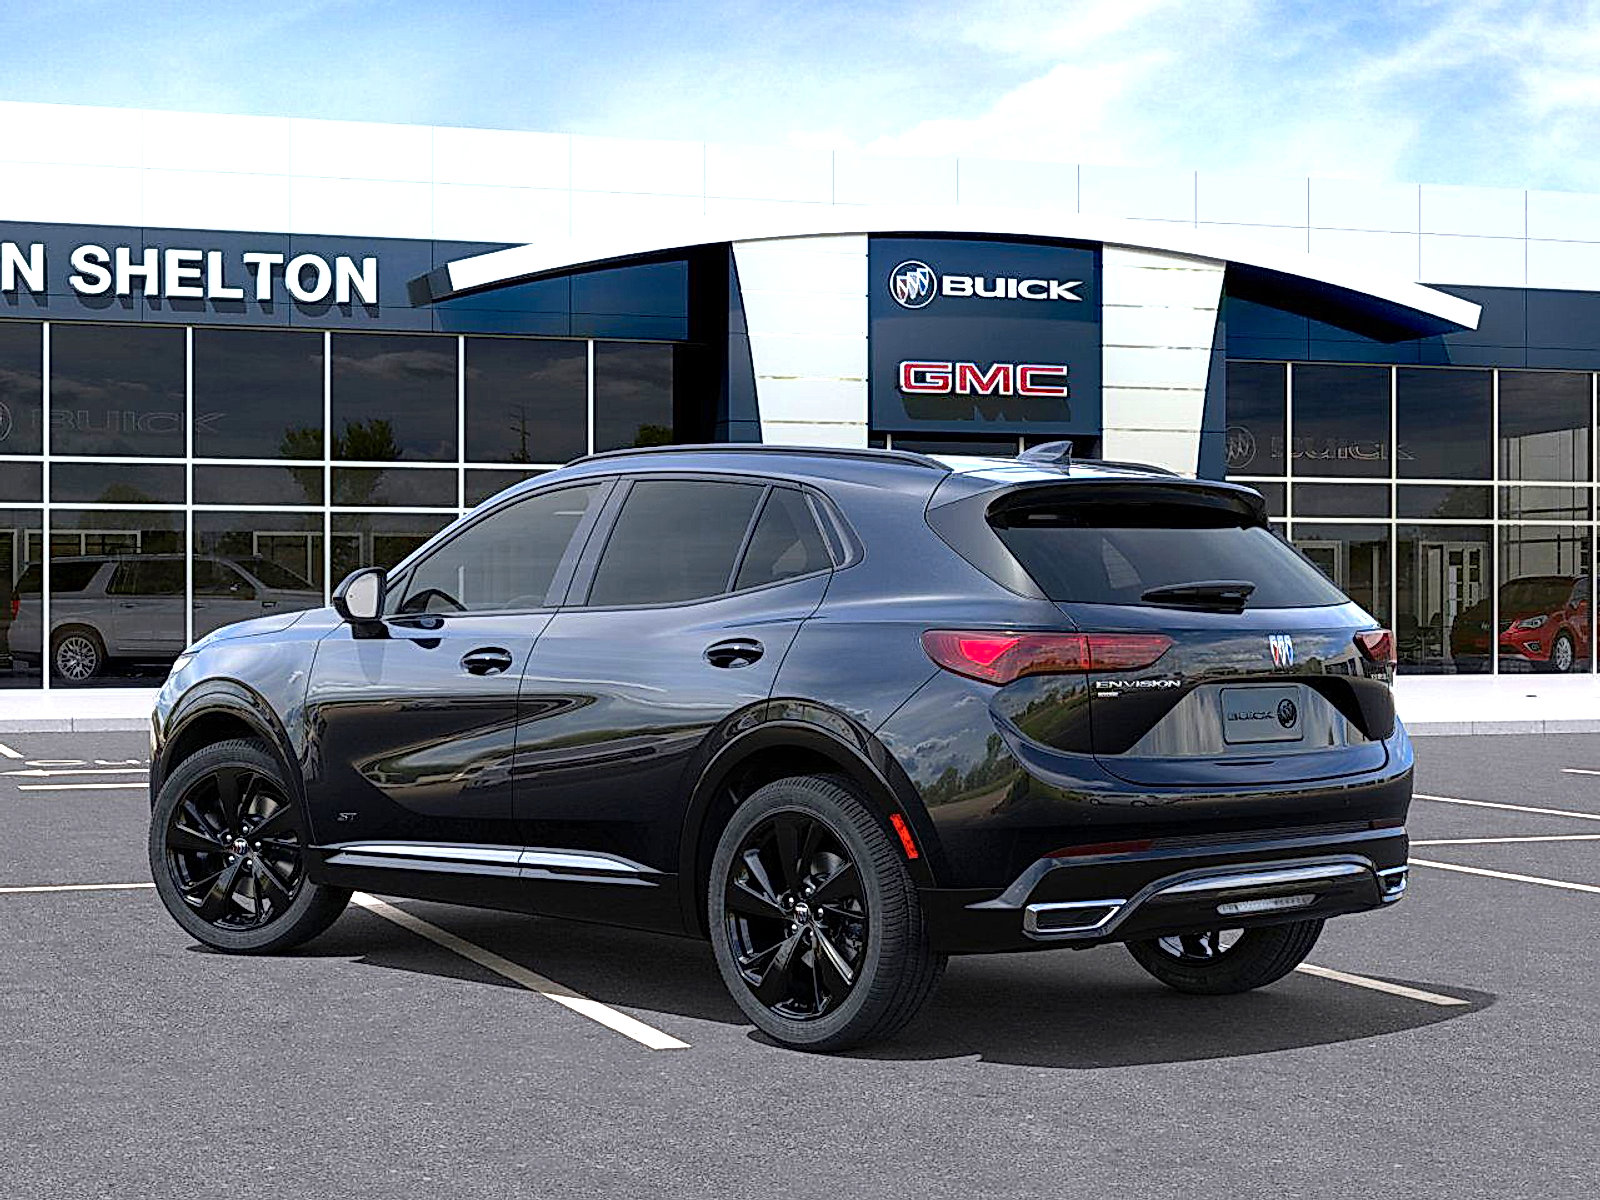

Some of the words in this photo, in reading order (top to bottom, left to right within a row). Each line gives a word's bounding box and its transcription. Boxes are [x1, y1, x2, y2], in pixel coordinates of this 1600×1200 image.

[71, 244, 378, 303] SHELTON
[942, 275, 1083, 301] BUICK
[899, 361, 1068, 397] GMC
[1096, 680, 1181, 689] ENVISION
[1227, 711, 1275, 720] BUICK
